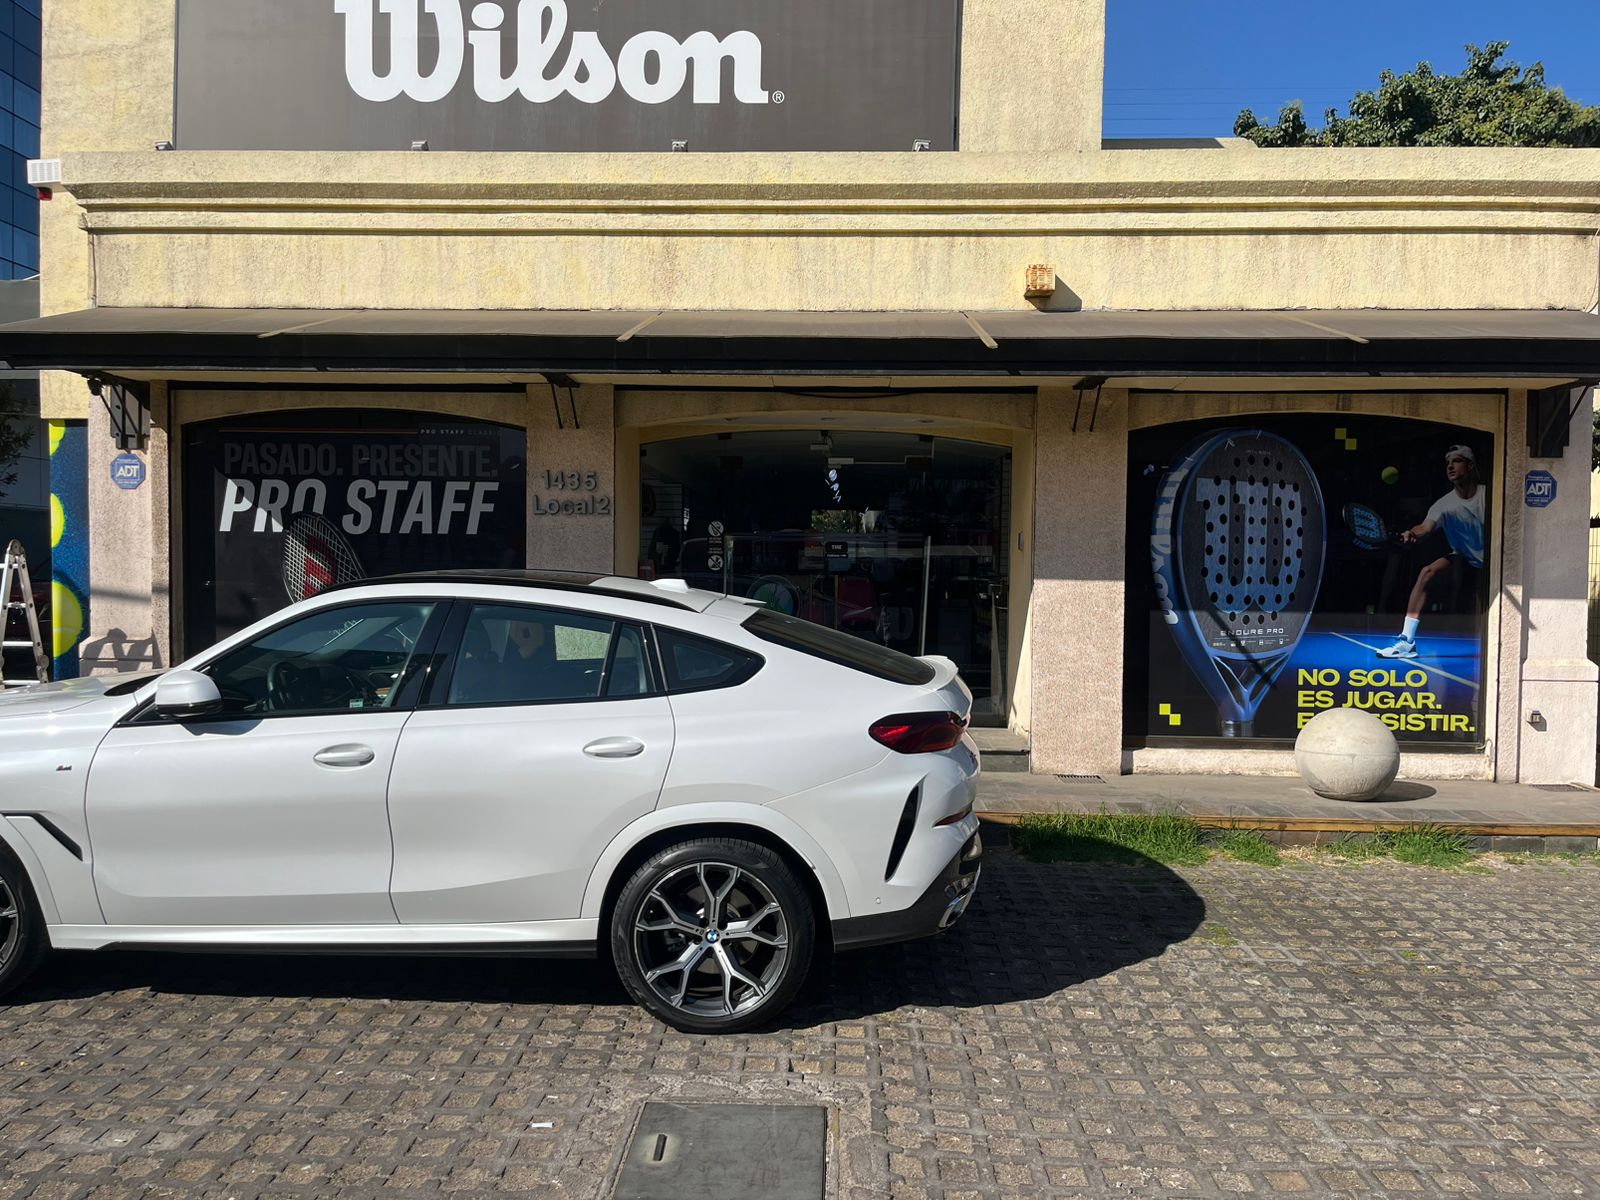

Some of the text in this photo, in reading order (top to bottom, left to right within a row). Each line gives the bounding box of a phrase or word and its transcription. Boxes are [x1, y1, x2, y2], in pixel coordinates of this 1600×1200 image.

[223, 442, 499, 478] PASADO. PRESENTE.
[116, 464, 140, 478] ADT
[542, 469, 597, 492] 1435
[1526, 482, 1552, 496] ADT
[219, 478, 500, 535] PRO STAFF
[1220, 628, 1263, 636] ENDURE
[1297, 668, 1428, 688] NO SOLO
[1297, 690, 1442, 710] ES JUGAR.
